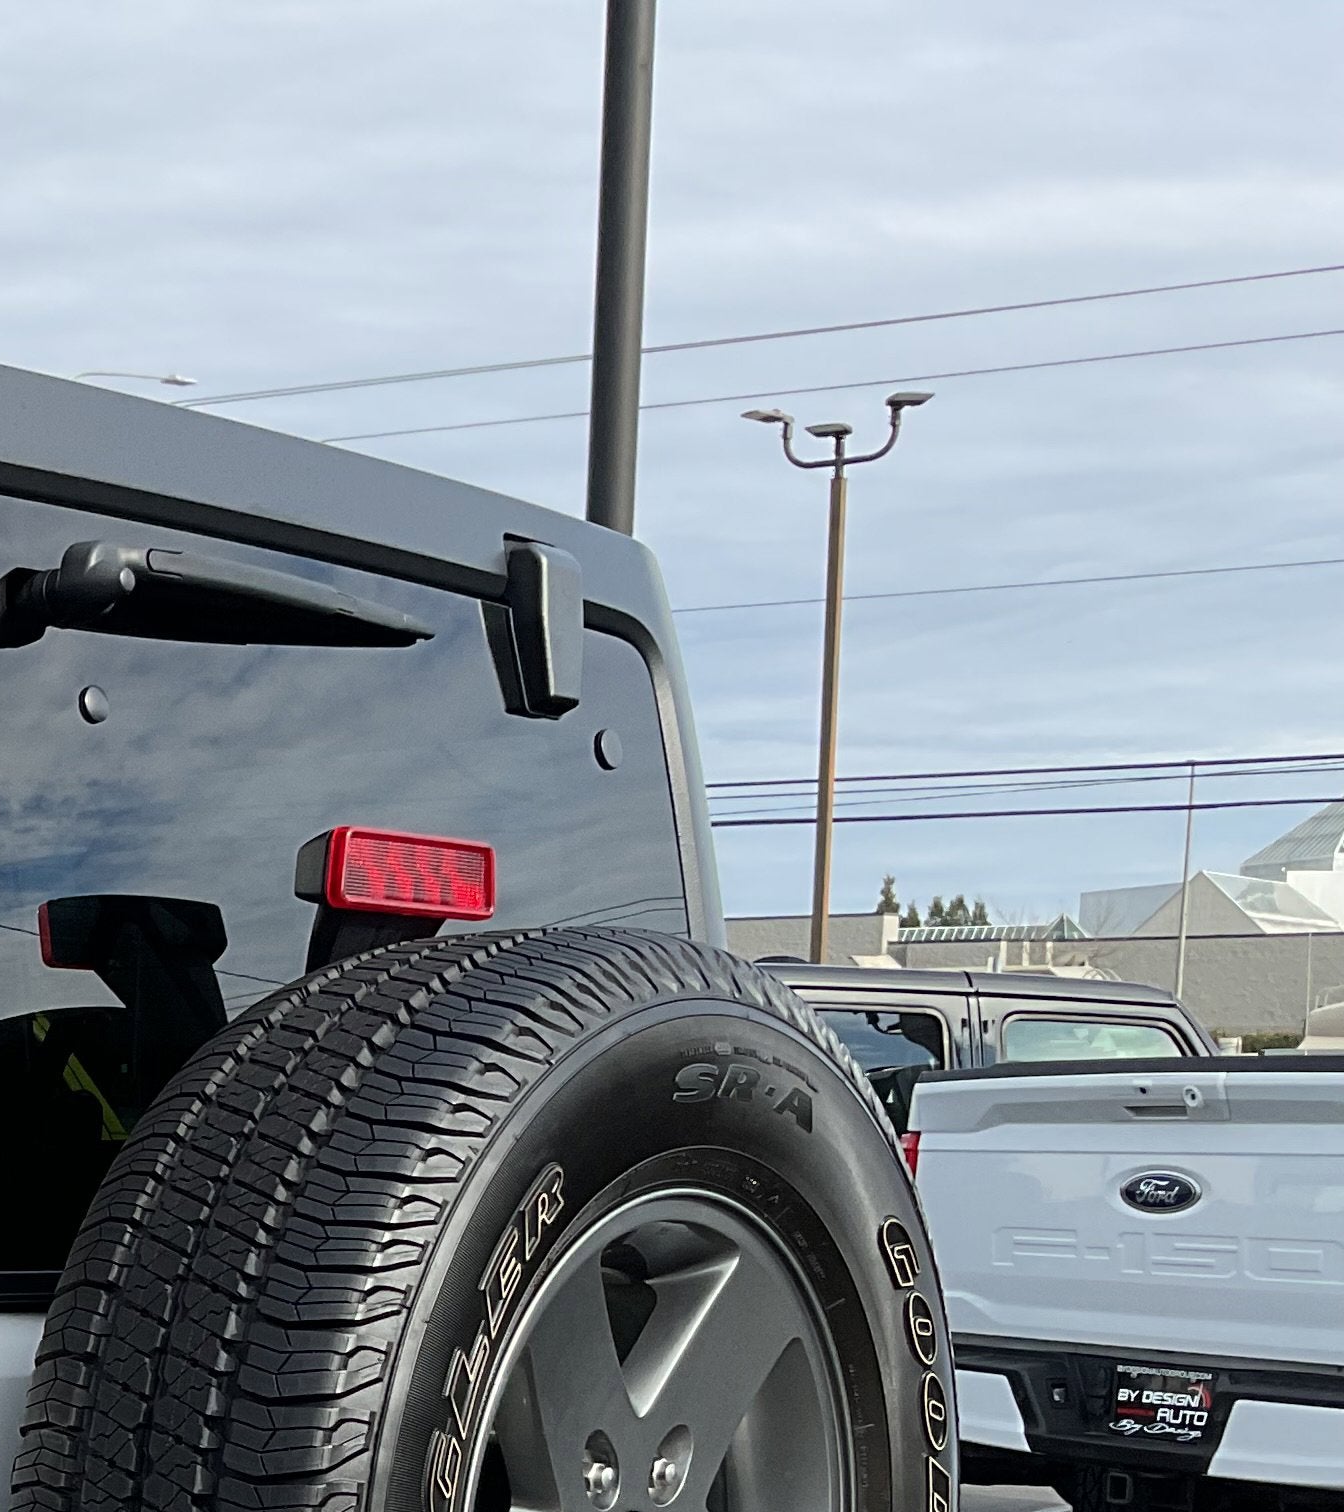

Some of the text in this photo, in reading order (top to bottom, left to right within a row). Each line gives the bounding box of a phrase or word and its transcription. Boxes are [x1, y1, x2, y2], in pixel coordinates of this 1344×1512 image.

[1136, 1178, 1180, 1204] Ford
[1118, 1389, 1200, 1408] BY DESIGN
[1156, 1408, 1208, 1426] AUTO
